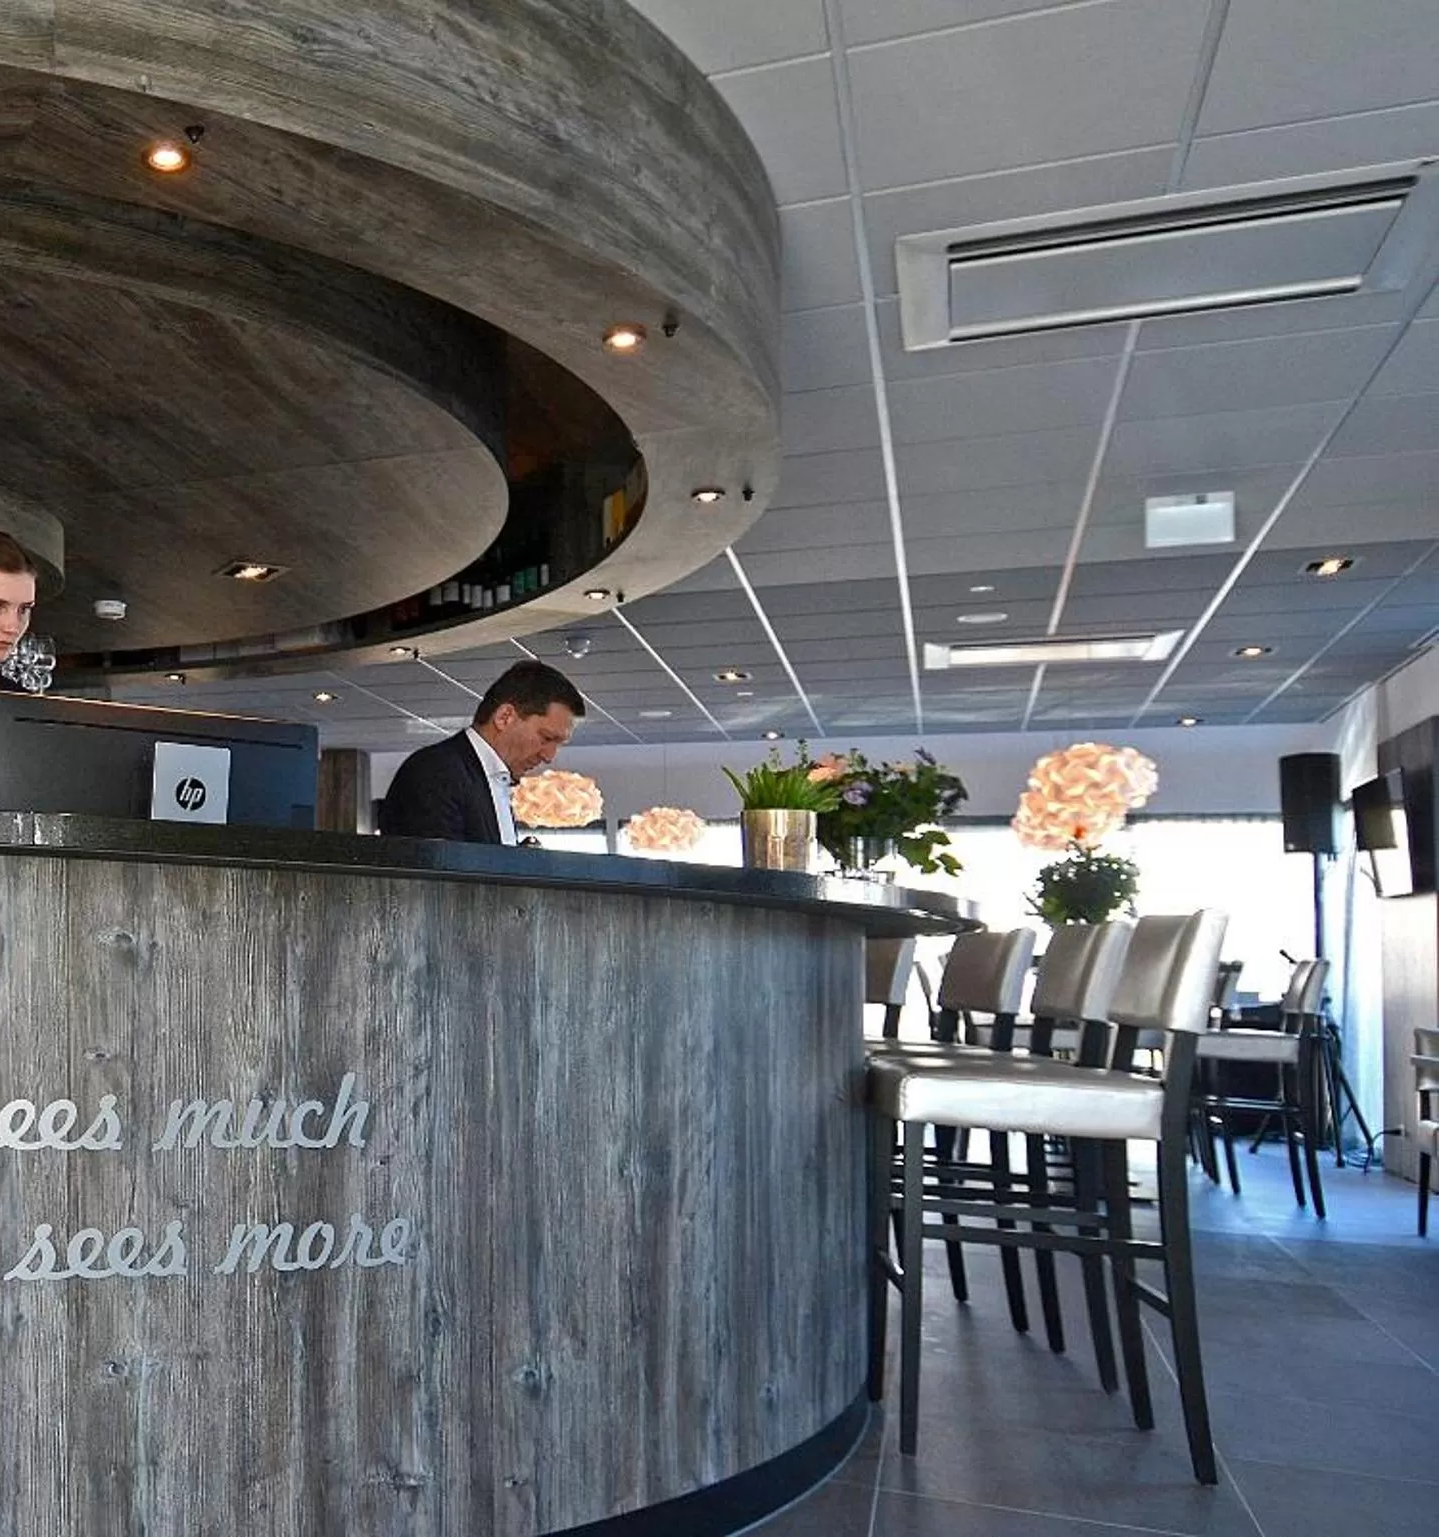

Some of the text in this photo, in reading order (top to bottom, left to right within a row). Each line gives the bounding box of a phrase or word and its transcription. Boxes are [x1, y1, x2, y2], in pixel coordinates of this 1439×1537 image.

[179, 778, 204, 810] hp
[153, 1072, 371, 1150] much
[4, 1220, 188, 1280] sees
[213, 1216, 413, 1274] more
